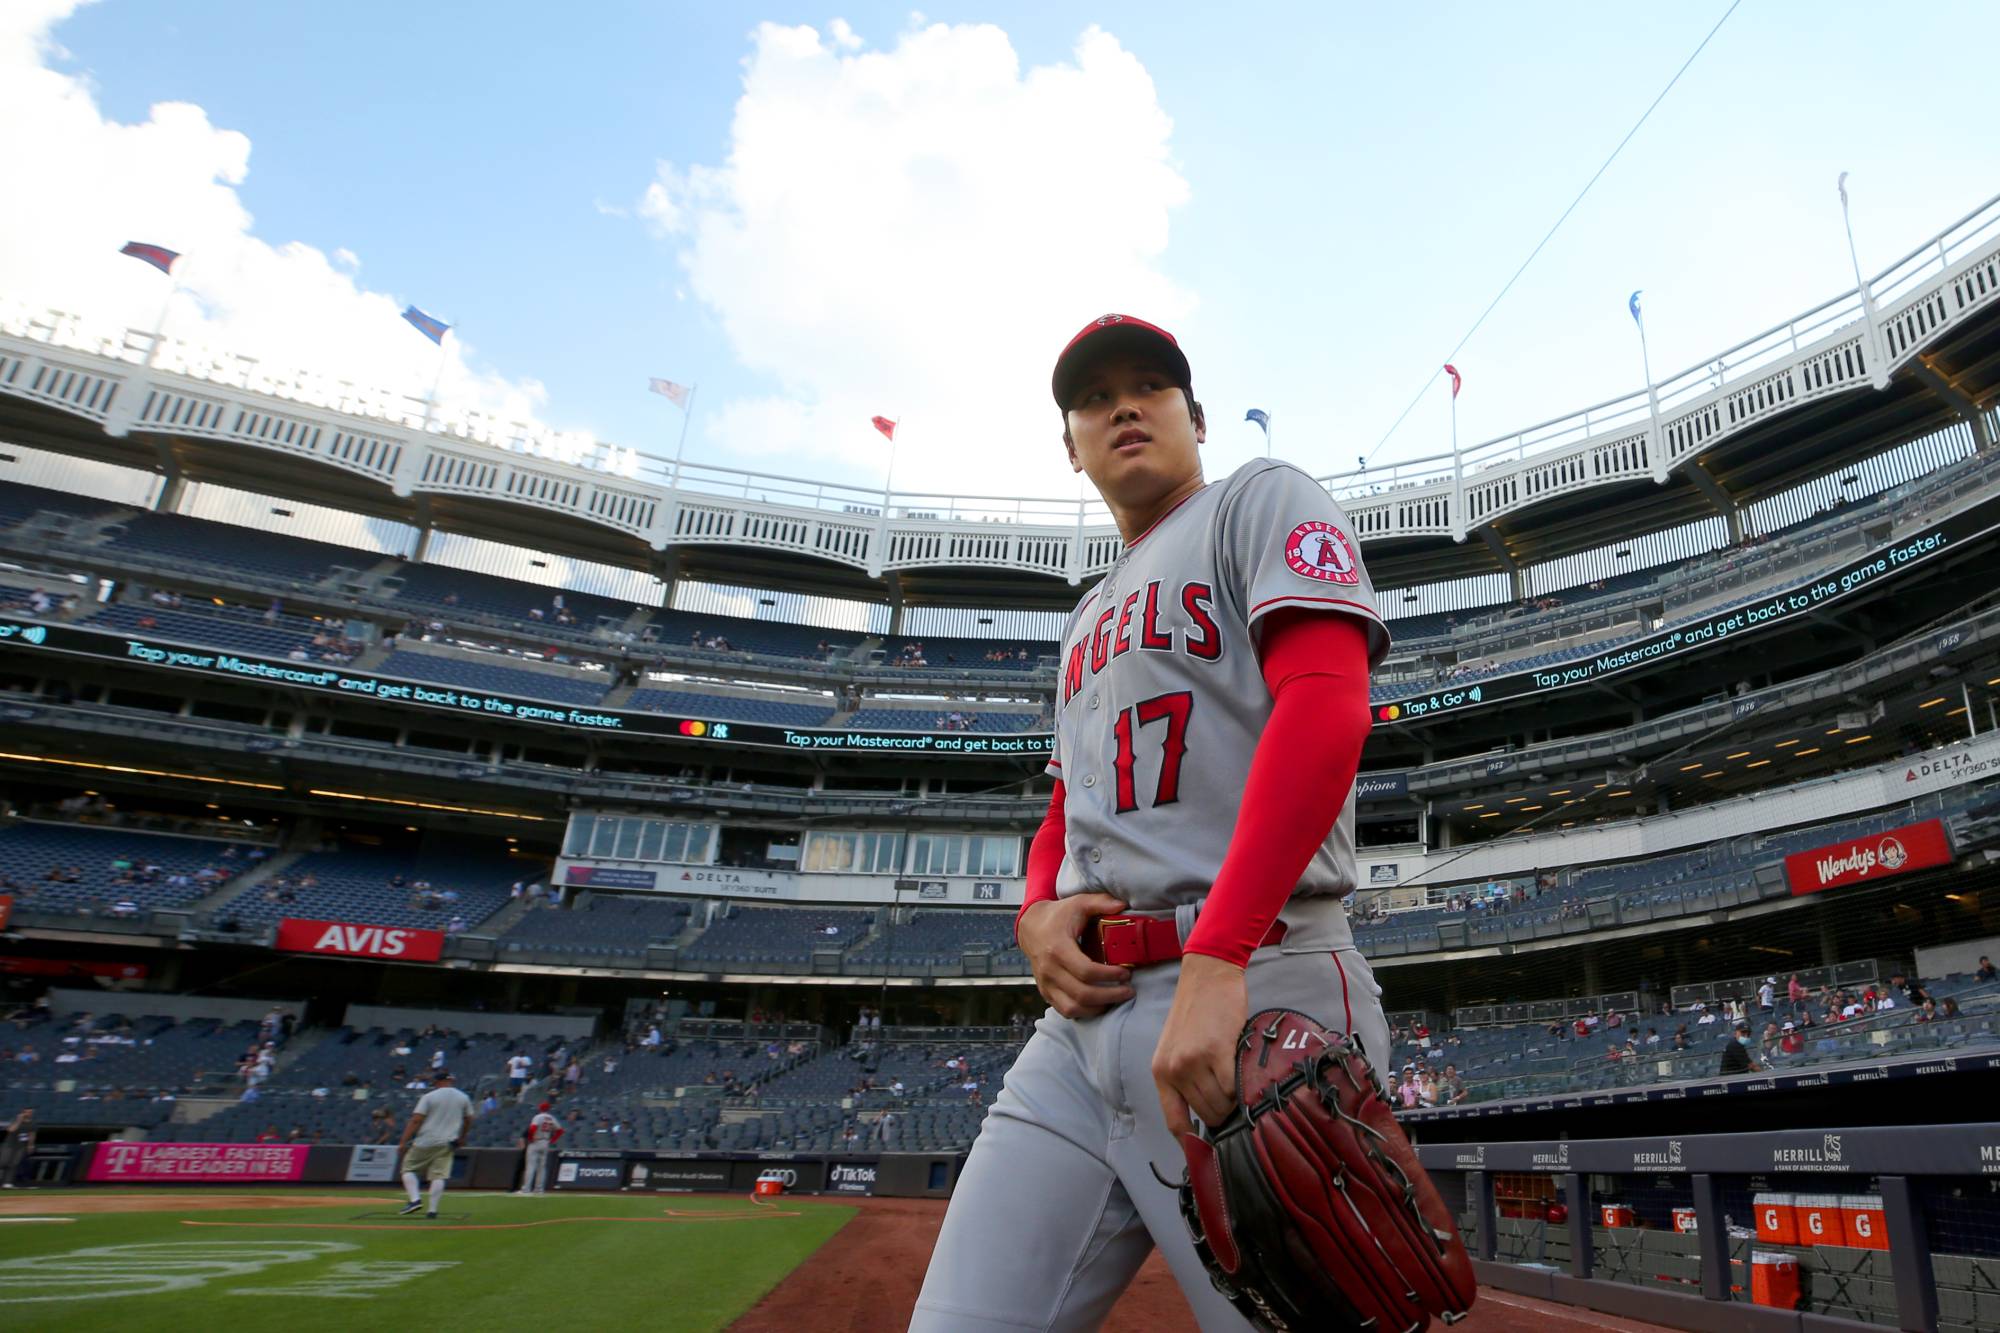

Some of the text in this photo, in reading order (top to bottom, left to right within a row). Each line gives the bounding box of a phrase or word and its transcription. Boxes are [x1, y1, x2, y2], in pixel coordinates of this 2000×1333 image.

[1533, 672, 1560, 689] Tap
[1563, 665, 1594, 685] your
[1685, 625, 1714, 645] and
[1716, 614, 1744, 638] get
[1747, 600, 1786, 624] back
[1788, 594, 1809, 611] to
[1811, 580, 1837, 602] the
[1840, 560, 1887, 592] game
[1889, 530, 1947, 566] faster.
[1063, 578, 1223, 712] NGELS
[1938, 632, 1961, 650] 1958
[126, 641, 164, 663] Tap
[167, 650, 215, 667] your
[338, 676, 376, 694] and
[377, 682, 411, 700] get
[413, 686, 457, 706] back
[459, 694, 482, 709] to
[483, 696, 513, 714] the
[516, 704, 565, 723] game
[569, 710, 623, 728] faster.
[1403, 700, 1427, 716] Tap
[1430, 697, 1441, 710] &
[1735, 701, 1756, 716] 1956
[784, 730, 811, 748] Tap
[813, 735, 846, 749] your
[935, 737, 961, 750] and
[964, 738, 988, 752] get
[991, 737, 1023, 751] back
[1026, 739, 1042, 750] to
[1113, 690, 1193, 815] 17
[1921, 752, 1973, 776] DELTA
[1816, 846, 1876, 885] Wendy's
[696, 872, 741, 883] DELTA
[314, 924, 406, 955] AVIS
[1853, 1073, 1880, 1081] MERRILL
[1916, 1065, 1946, 1075] MERRILL
[141, 1147, 295, 1160] LARGEST. FASTEST.
[1532, 1154, 1558, 1164] MERRILL
[1634, 1153, 1668, 1164] MERRILL
[1774, 1149, 1822, 1162] MERRILL
[140, 1160, 293, 1173] THE LEADER IN 5G
[578, 1167, 618, 1177] TOYOTA
[842, 1167, 876, 1182] TikTok
[1605, 1209, 1614, 1224] G
[1765, 1209, 1779, 1231] G
[1808, 1212, 1824, 1235] G
[1855, 1214, 1872, 1237] G
